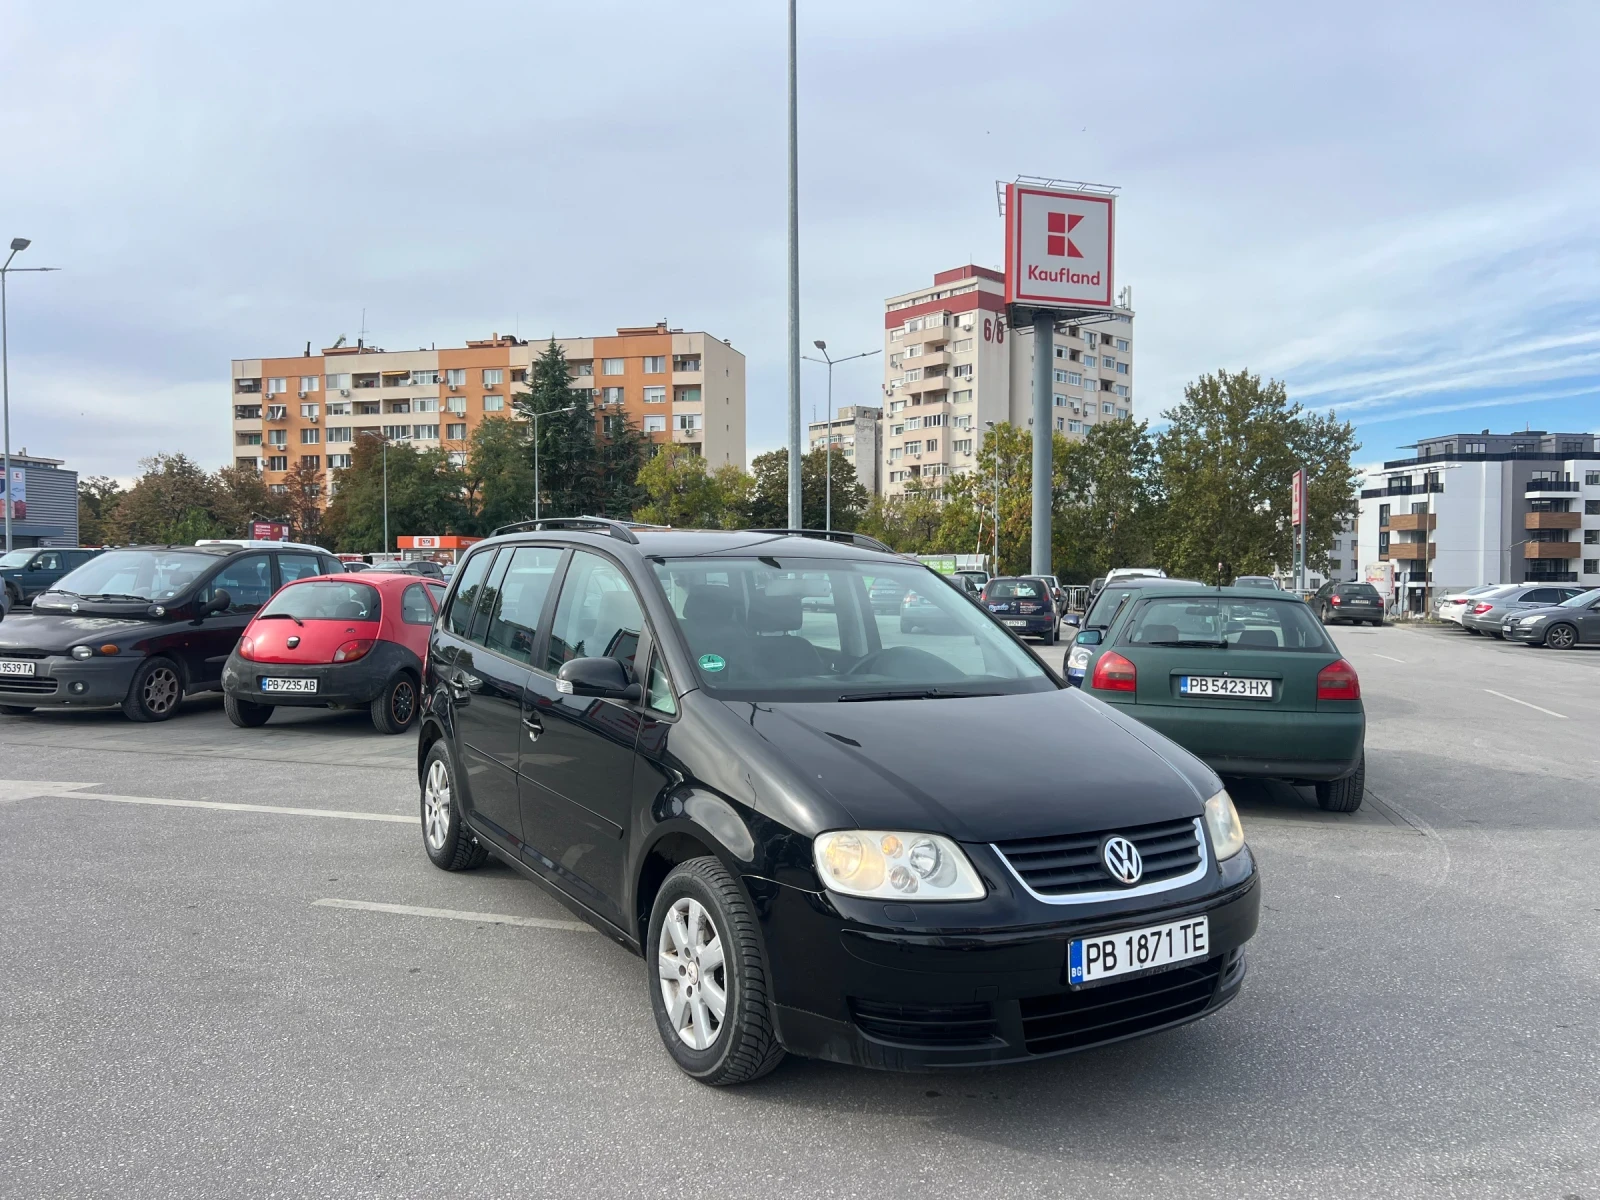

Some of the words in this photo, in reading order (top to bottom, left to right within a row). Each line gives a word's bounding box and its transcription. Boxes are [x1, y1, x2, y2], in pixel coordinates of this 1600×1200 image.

[1028, 265, 1101, 286] Kaufland
[984, 318, 1004, 344] 6/8
[2, 663, 21, 673] 9539
[22, 664, 33, 674] TA
[268, 680, 278, 689] PB
[280, 680, 302, 690] 7235
[304, 681, 316, 690] AB
[1190, 678, 1209, 692] PB
[1212, 679, 1246, 693] 5423
[1250, 681, 1268, 695] HX
[1086, 940, 1118, 975] PB
[1126, 928, 1172, 966] 1871
[1180, 921, 1205, 954] TE
[1071, 966, 1082, 977] BG
